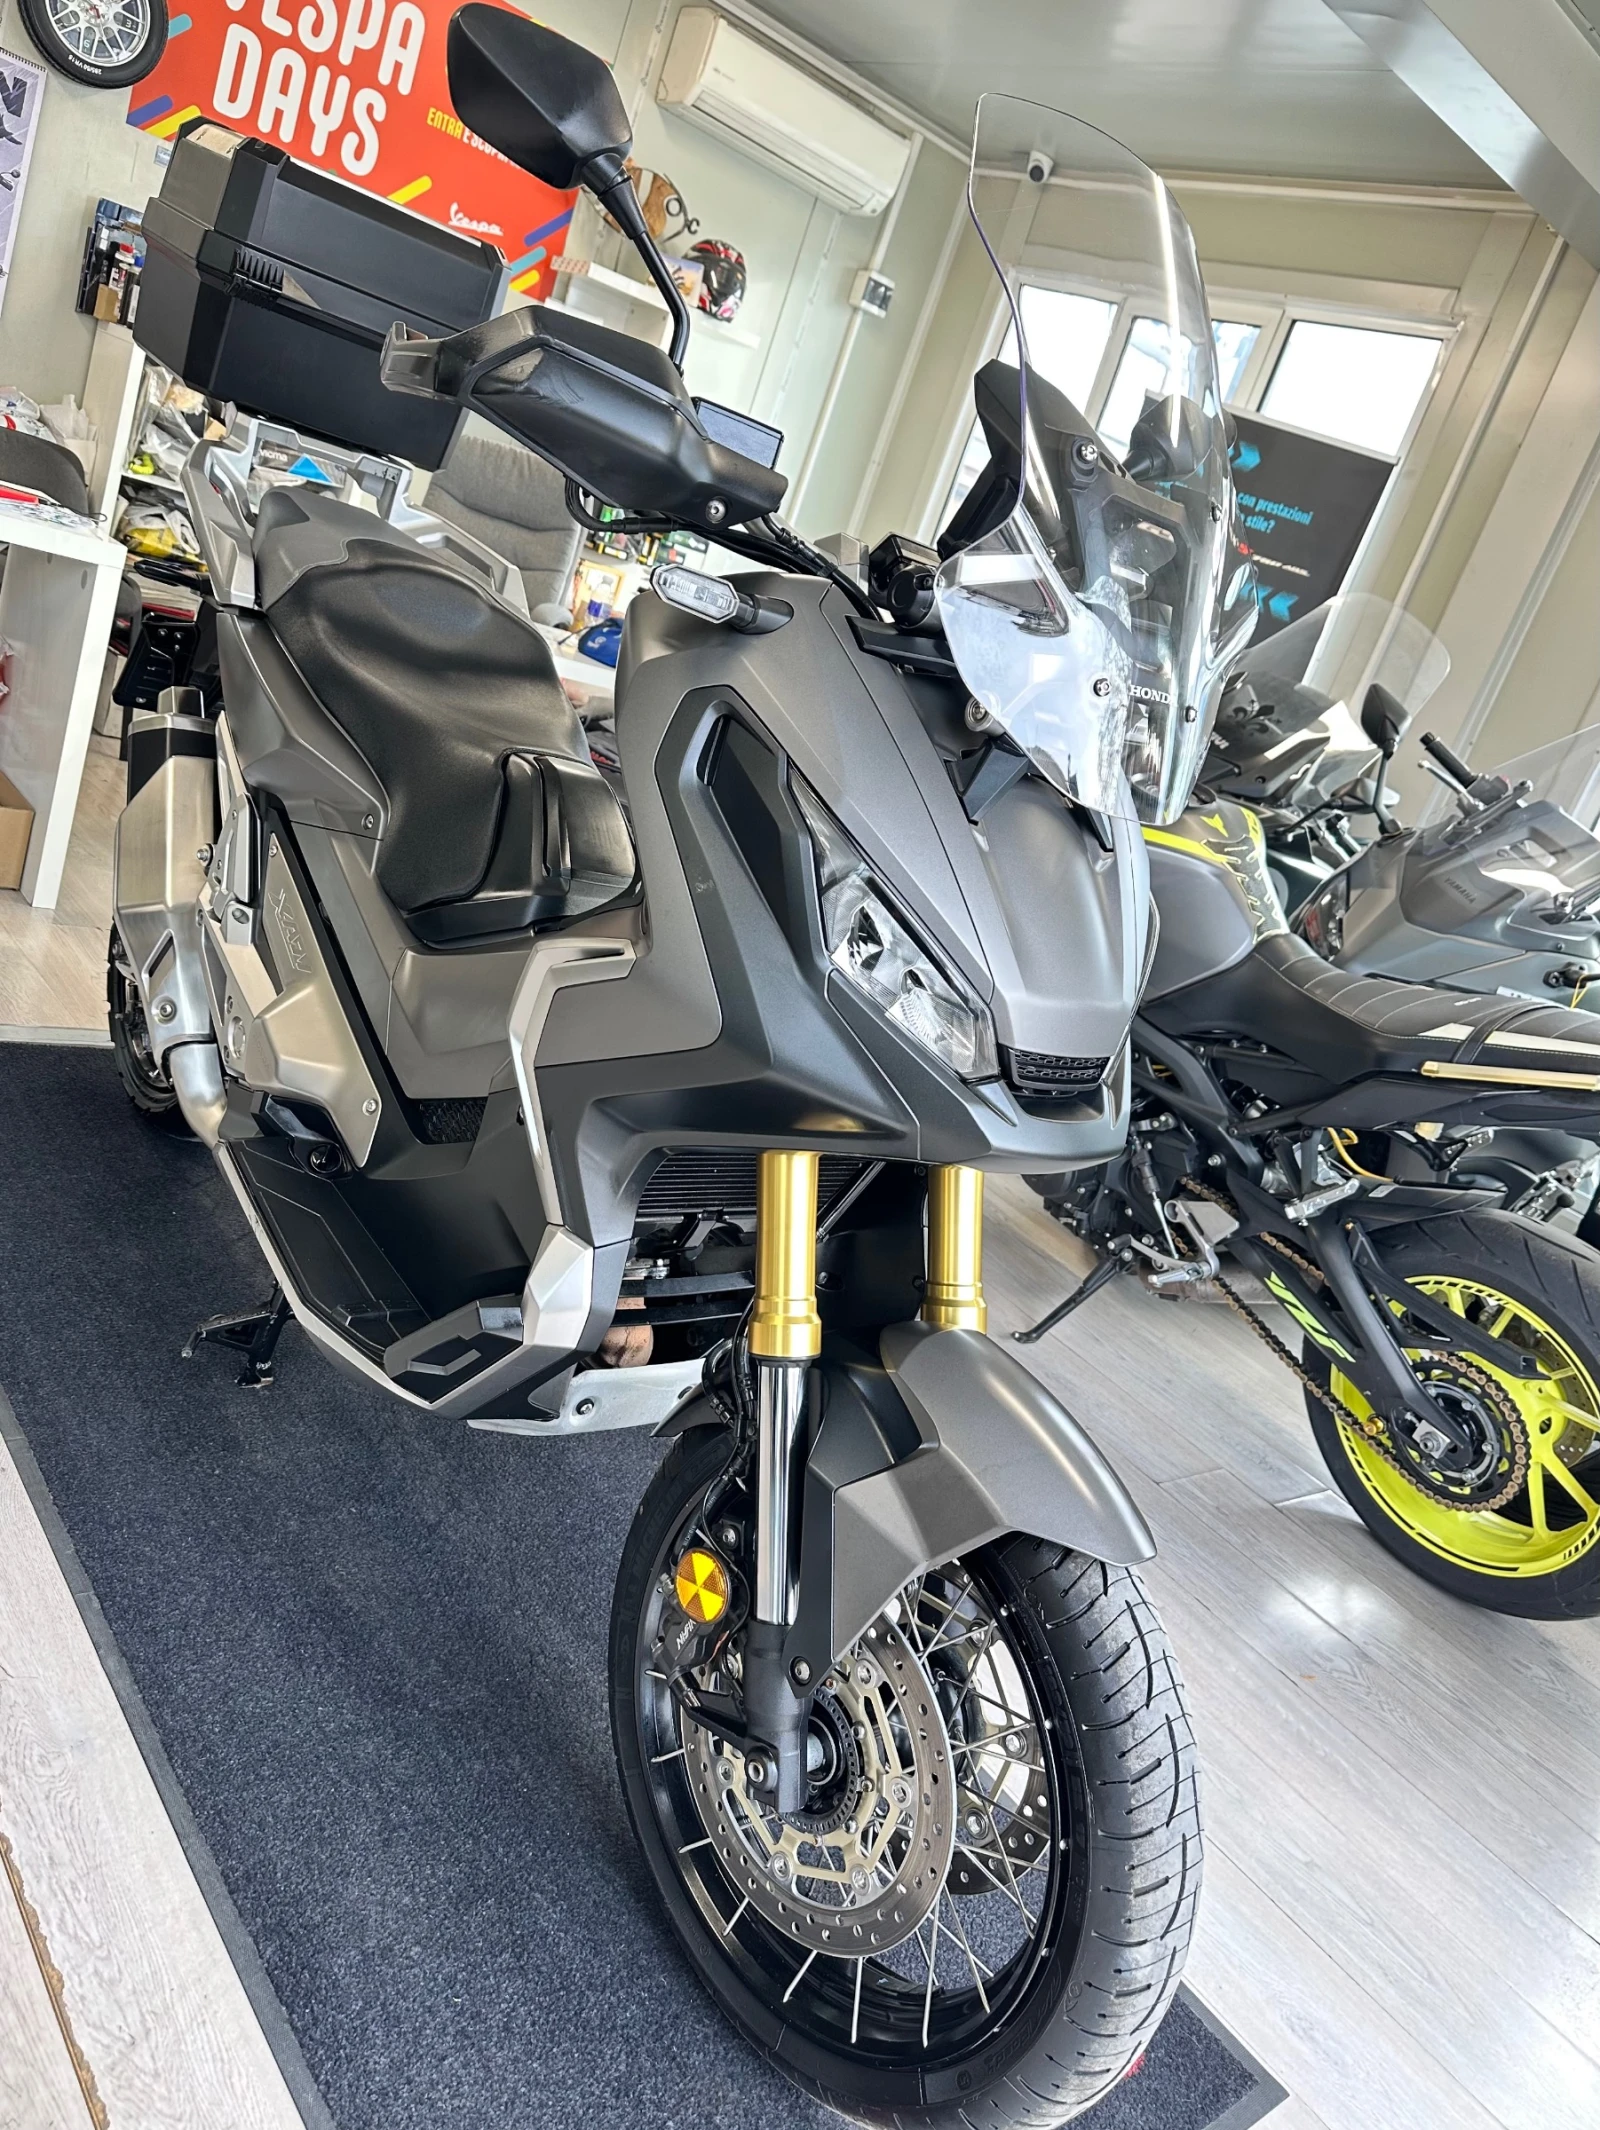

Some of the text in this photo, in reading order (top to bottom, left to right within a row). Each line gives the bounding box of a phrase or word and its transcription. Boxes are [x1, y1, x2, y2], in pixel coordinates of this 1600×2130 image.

[226, 0, 425, 95] SPA
[213, 23, 387, 177] DAYS
[427, 107, 464, 139] ENTRA
[448, 202, 504, 236] Vespa
[1237, 492, 1257, 508] con
[1255, 495, 1314, 525] prestazioni
[1245, 514, 1275, 534] stile?
[1129, 684, 1172, 704] HOND
[1444, 876, 1477, 904] YAMAHA
